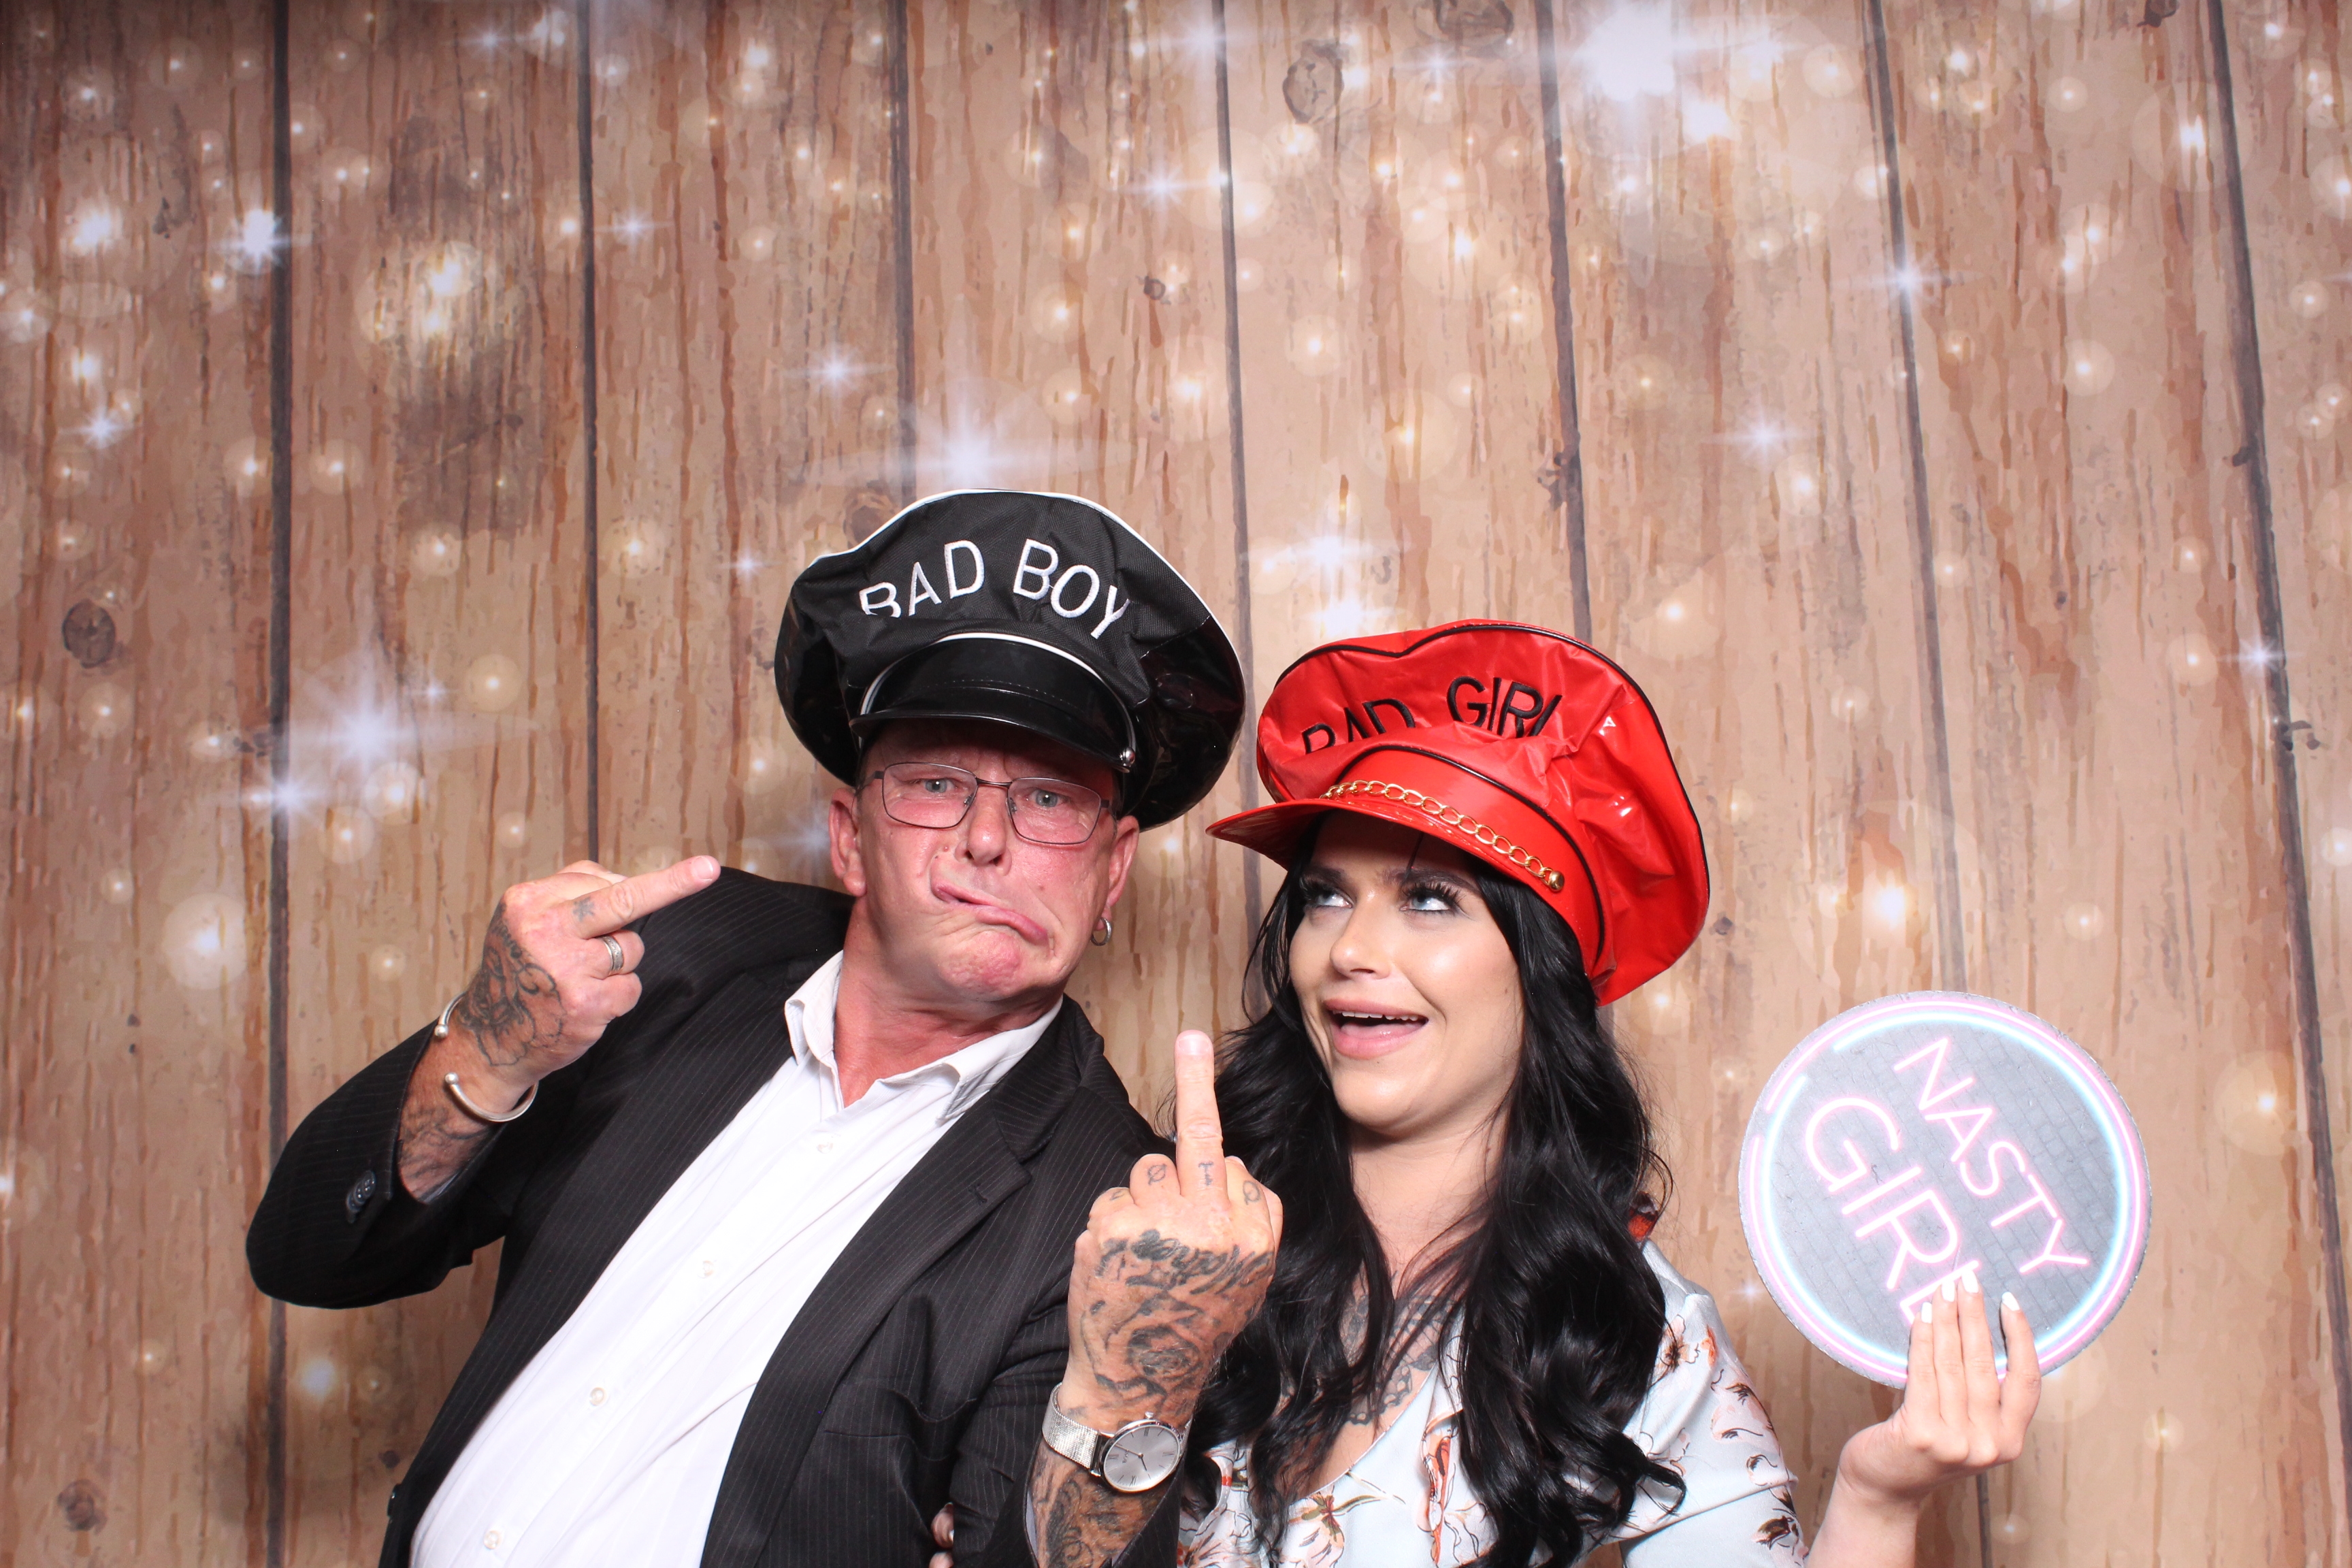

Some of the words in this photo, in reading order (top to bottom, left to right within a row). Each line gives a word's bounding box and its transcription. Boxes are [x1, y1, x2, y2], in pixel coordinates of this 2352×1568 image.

[859, 540, 985, 618] BAD
[1013, 538, 1131, 640] BOY
[1805, 1096, 1980, 1325] GIRL
[1893, 1036, 2089, 1274] NASTY
